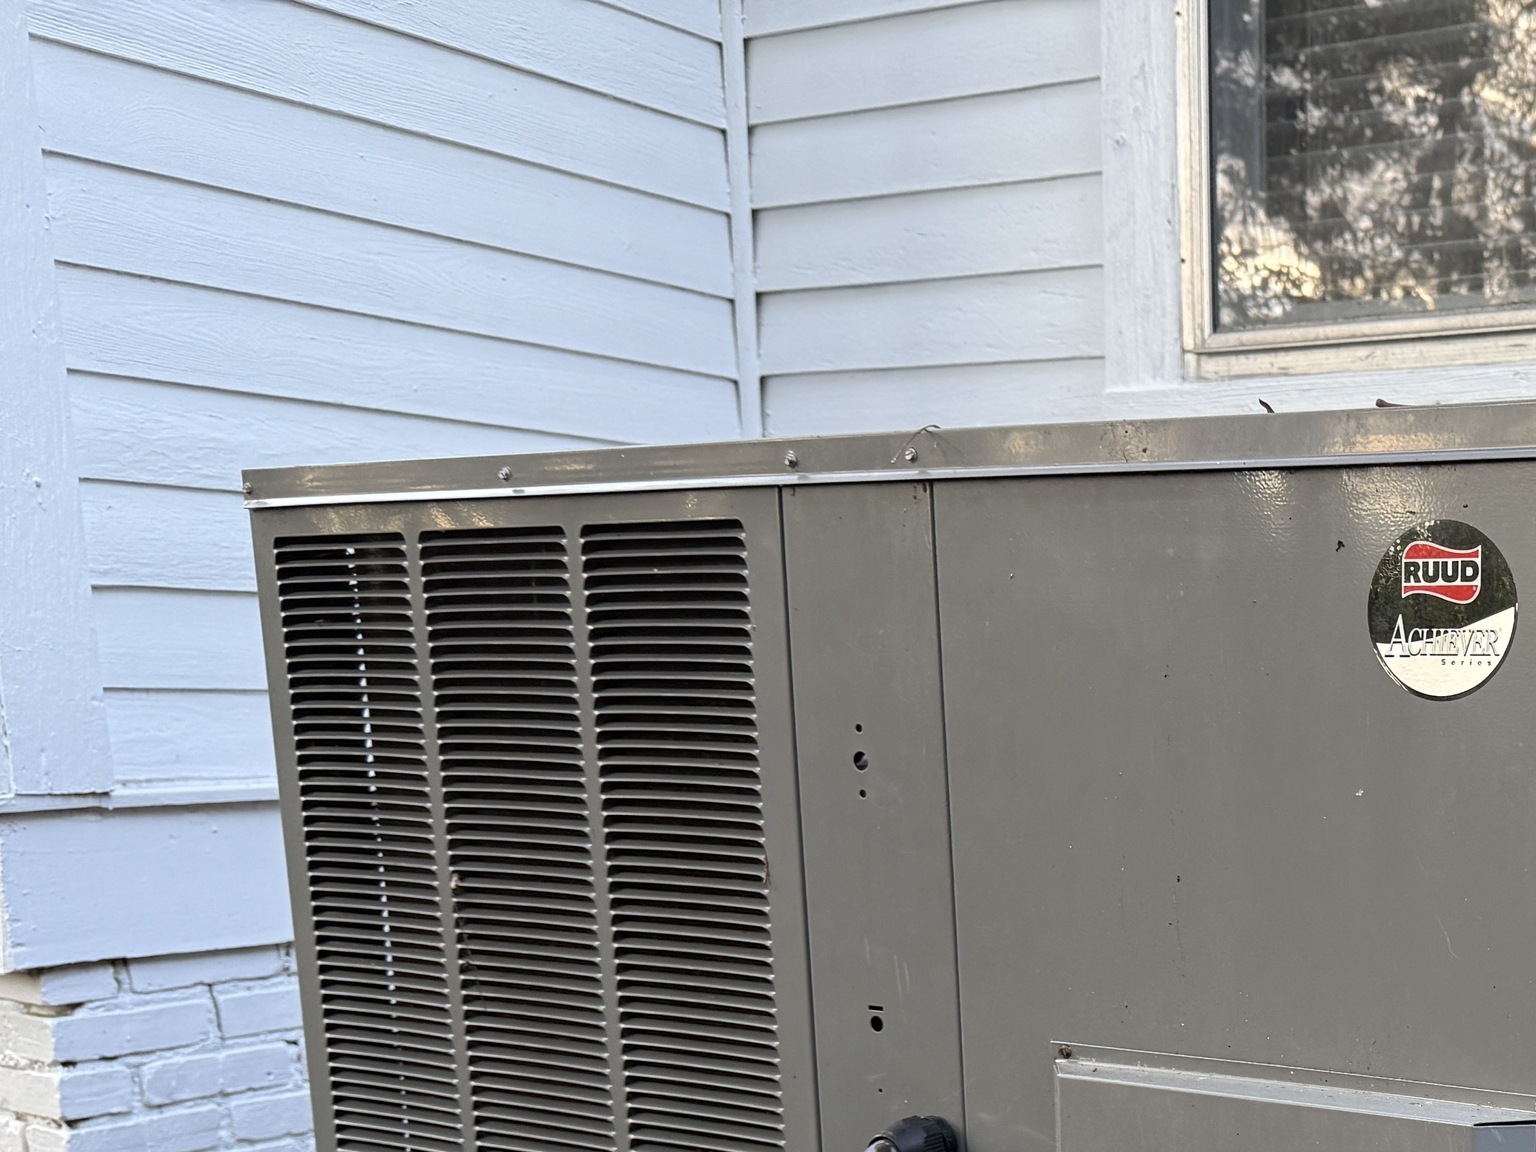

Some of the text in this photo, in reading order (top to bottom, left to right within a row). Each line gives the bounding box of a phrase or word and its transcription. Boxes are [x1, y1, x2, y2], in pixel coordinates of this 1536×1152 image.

[1404, 560, 1479, 583] RUUD
[1384, 614, 1500, 657] ACHIEVER
[1441, 658, 1491, 666] Series
